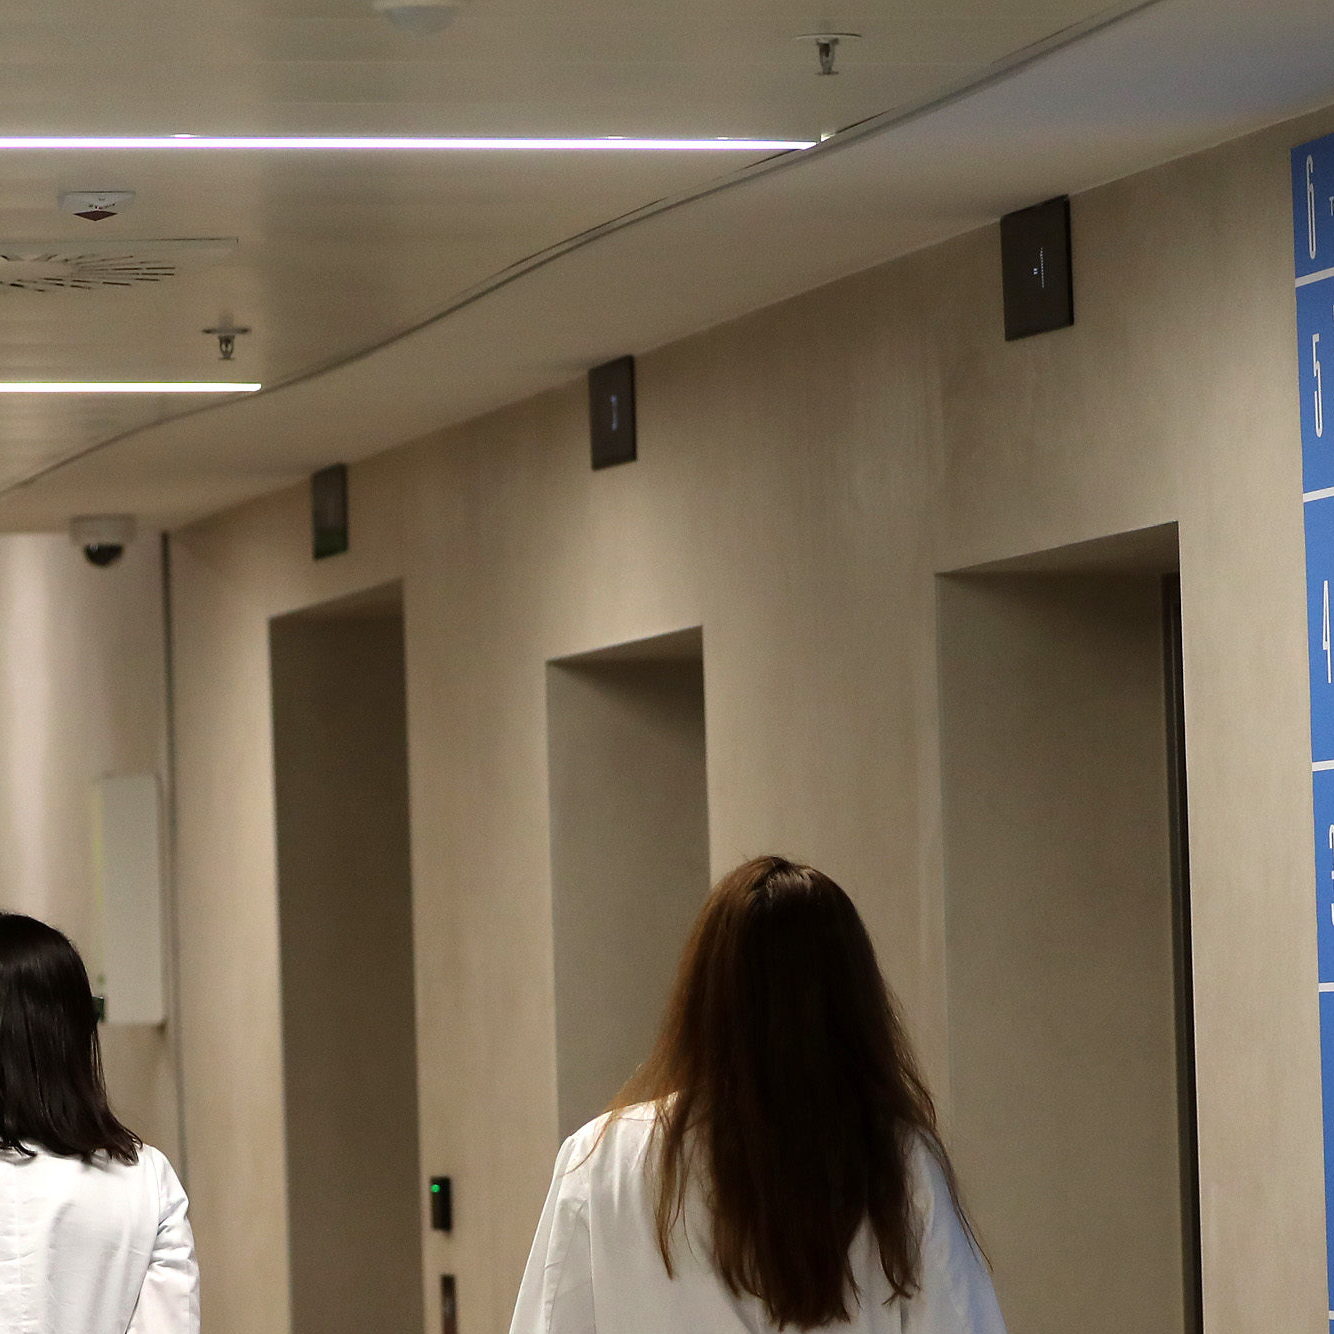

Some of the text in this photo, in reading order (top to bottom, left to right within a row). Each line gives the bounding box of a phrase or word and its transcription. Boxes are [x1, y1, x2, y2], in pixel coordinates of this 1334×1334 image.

[1306, 155, 1316, 259] 6
[1312, 333, 1323, 438] 5
[1322, 580, 1332, 684] 4
